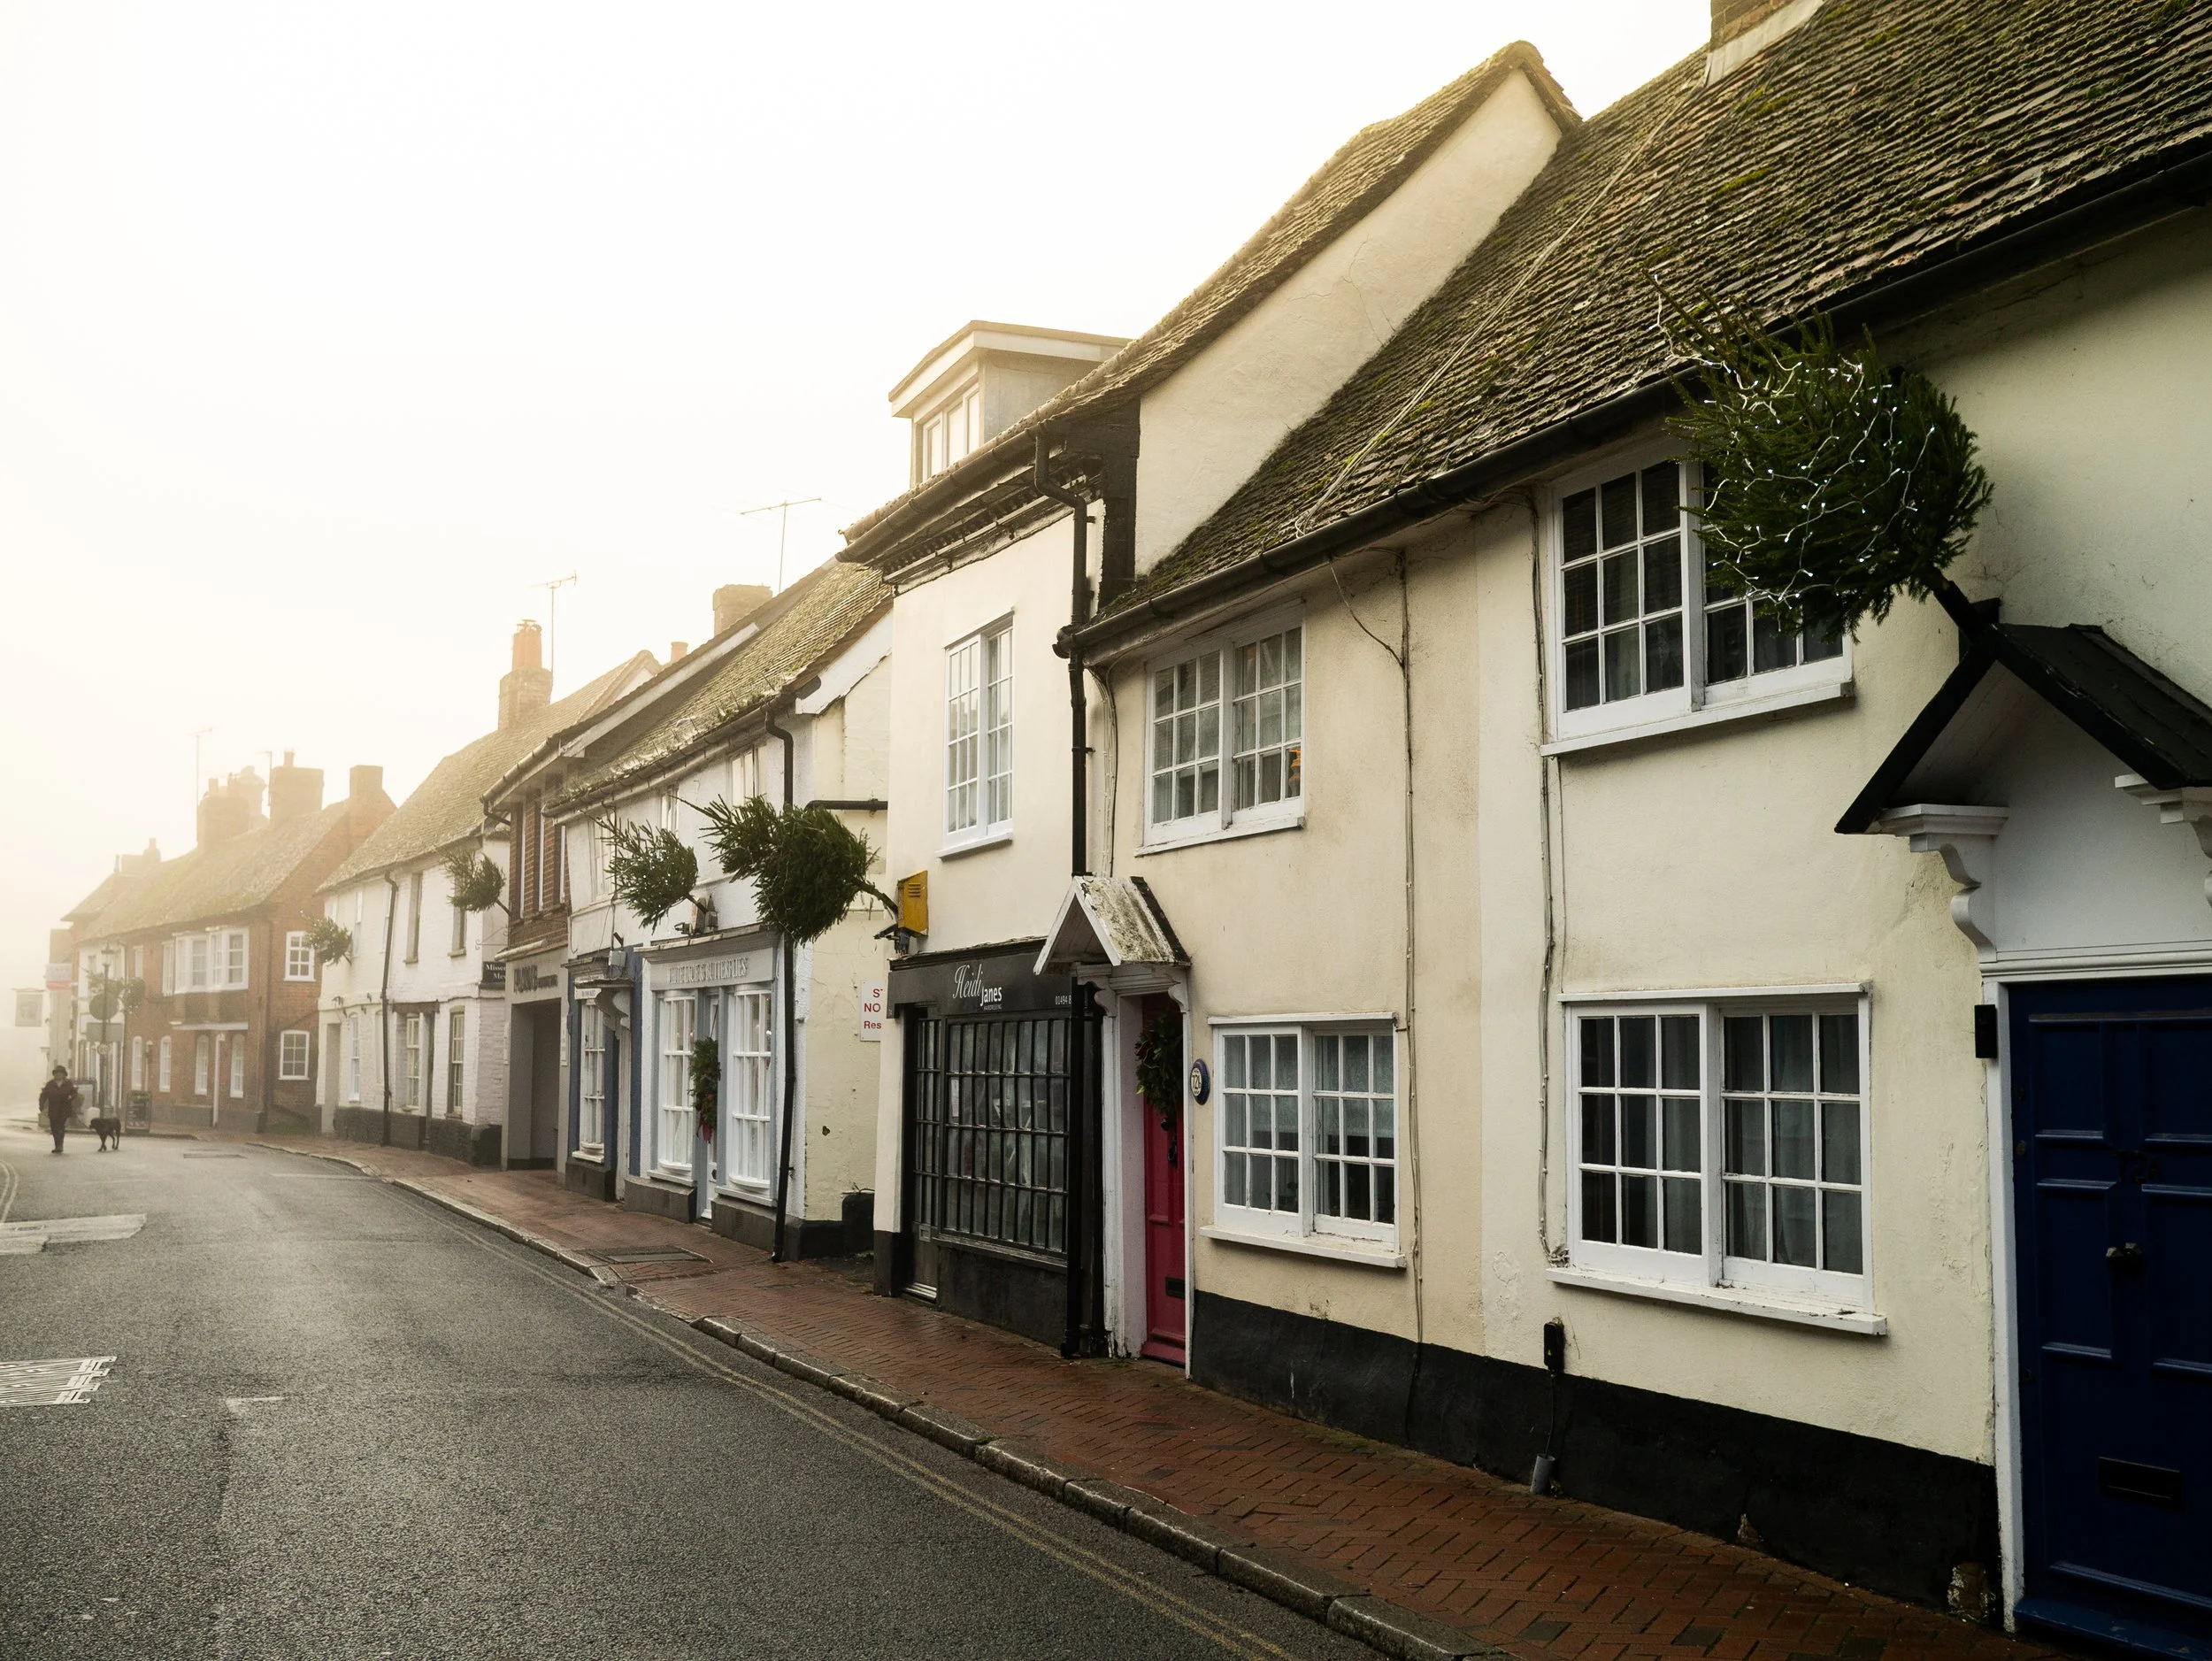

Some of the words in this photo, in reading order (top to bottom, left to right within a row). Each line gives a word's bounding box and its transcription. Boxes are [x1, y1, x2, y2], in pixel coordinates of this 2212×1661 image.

[706, 957, 749, 980] BUTTERFLIES
[953, 964, 983, 999] Heidi
[872, 988, 883, 998] S
[864, 1003, 881, 1013] NO
[864, 1020, 882, 1029] Res
